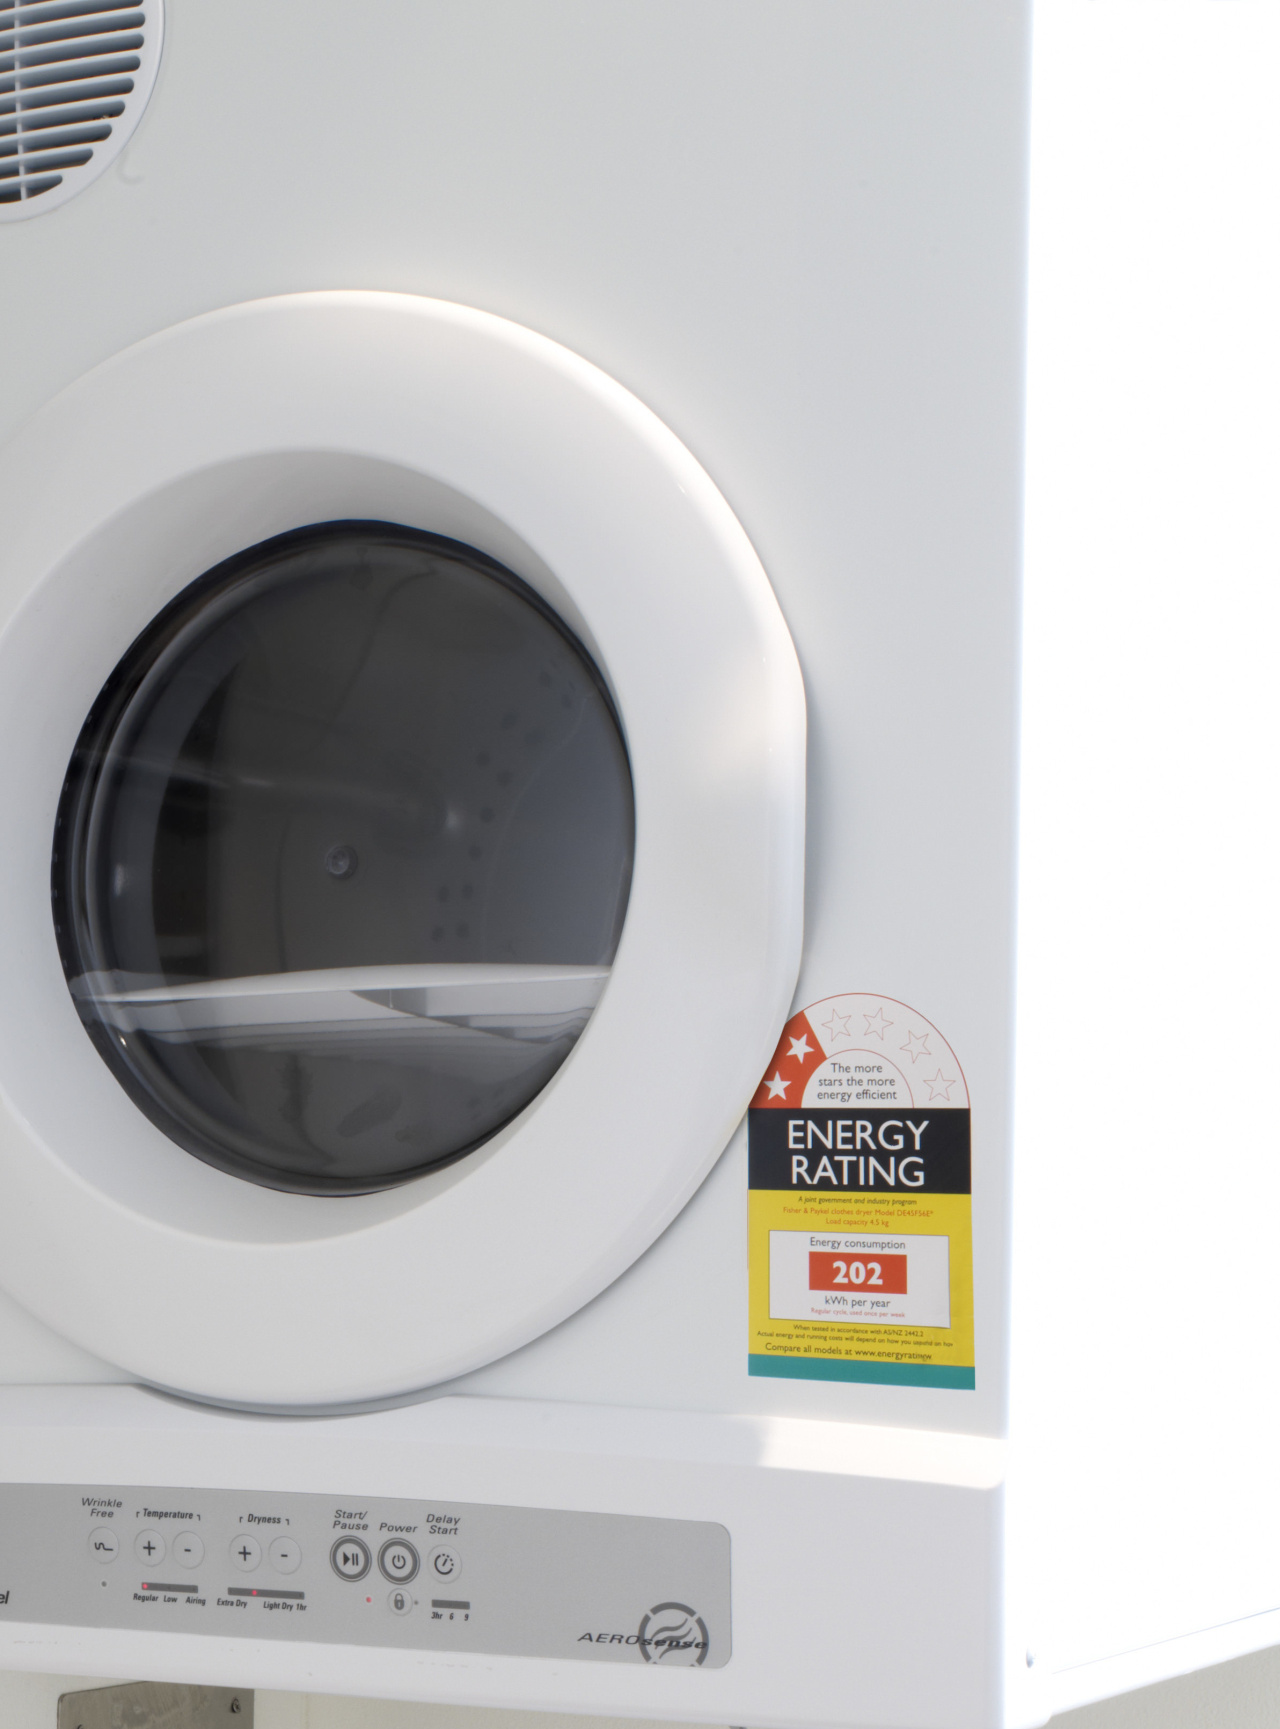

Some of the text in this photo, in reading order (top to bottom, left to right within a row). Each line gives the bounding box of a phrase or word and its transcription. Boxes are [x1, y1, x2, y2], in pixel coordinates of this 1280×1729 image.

[831, 1062, 883, 1073] The more
[818, 1076, 896, 1087] stars the more
[817, 1089, 897, 1103] energy efficient
[788, 1119, 930, 1151] ENERGY
[791, 1155, 925, 1187] RATING
[867, 1198, 890, 1206] industry
[810, 1207, 829, 1215] Paykel
[855, 1209, 872, 1217] dryer
[843, 1219, 867, 1227] capacity
[810, 1237, 906, 1251] Energy consumption
[832, 1260, 883, 1285] 202
[825, 1296, 891, 1309] kWh per year
[765, 1342, 801, 1353] Compare
[814, 1347, 842, 1355] models
[82, 1498, 123, 1508] Wrinkle
[90, 1508, 114, 1518] Free
[143, 1508, 194, 1519] Temperature
[334, 1510, 368, 1520] Start/
[247, 1514, 281, 1524] Dryness
[426, 1514, 461, 1525] Delay
[332, 1521, 369, 1531] Pause
[379, 1523, 418, 1533] Power
[429, 1525, 458, 1535] Start
[133, 1593, 206, 1606] Regular Low Airing
[217, 1598, 248, 1608] Extra Dry
[263, 1601, 307, 1611] Light Dry 1hr
[431, 1611, 443, 1620] 3hr
[464, 1613, 469, 1621] 9
